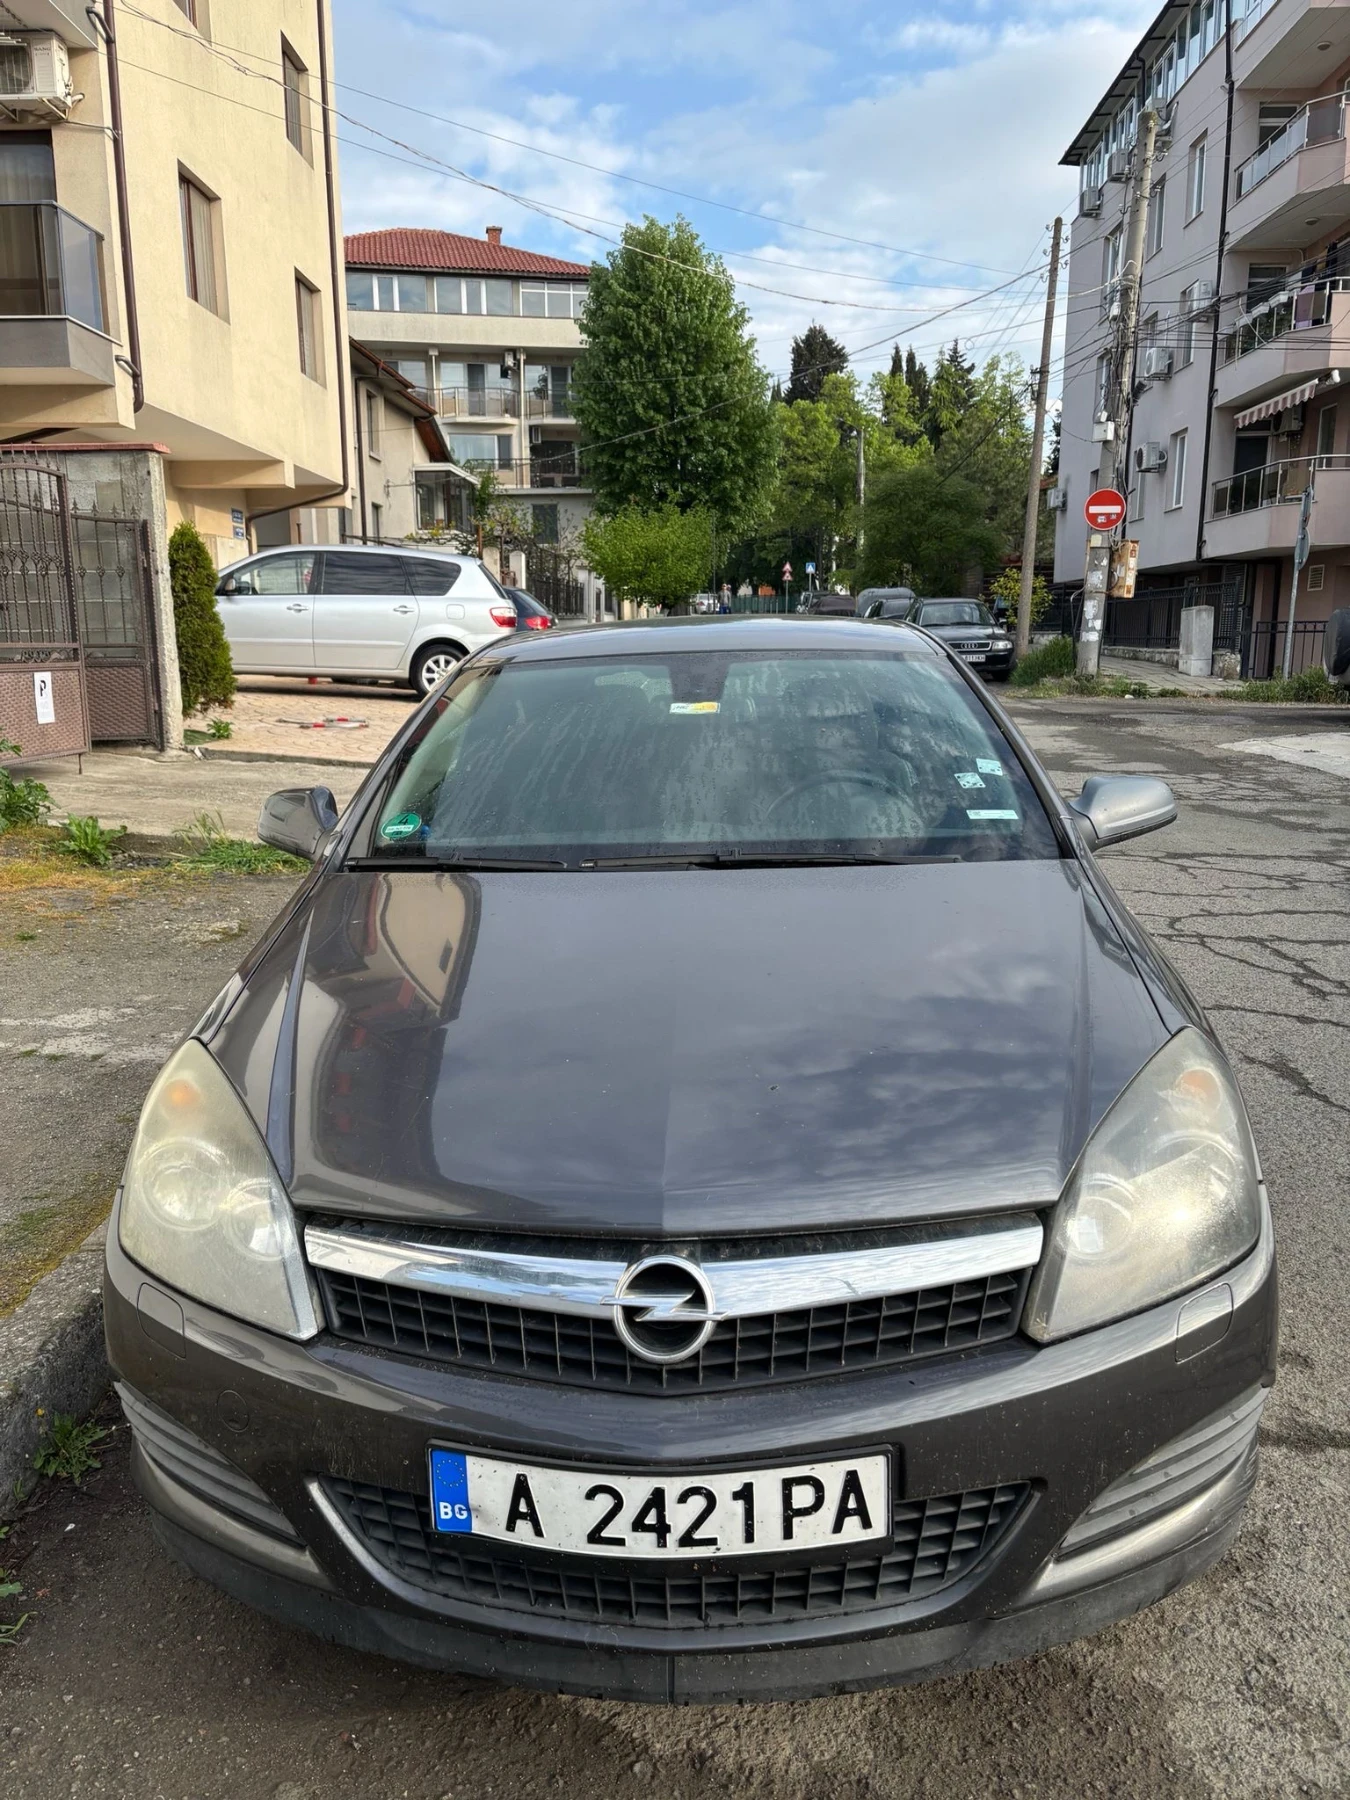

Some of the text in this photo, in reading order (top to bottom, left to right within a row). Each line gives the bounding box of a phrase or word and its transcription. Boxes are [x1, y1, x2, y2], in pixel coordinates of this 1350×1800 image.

[439, 1501, 469, 1520] BG
[506, 1469, 873, 1549] A 2421 PA
